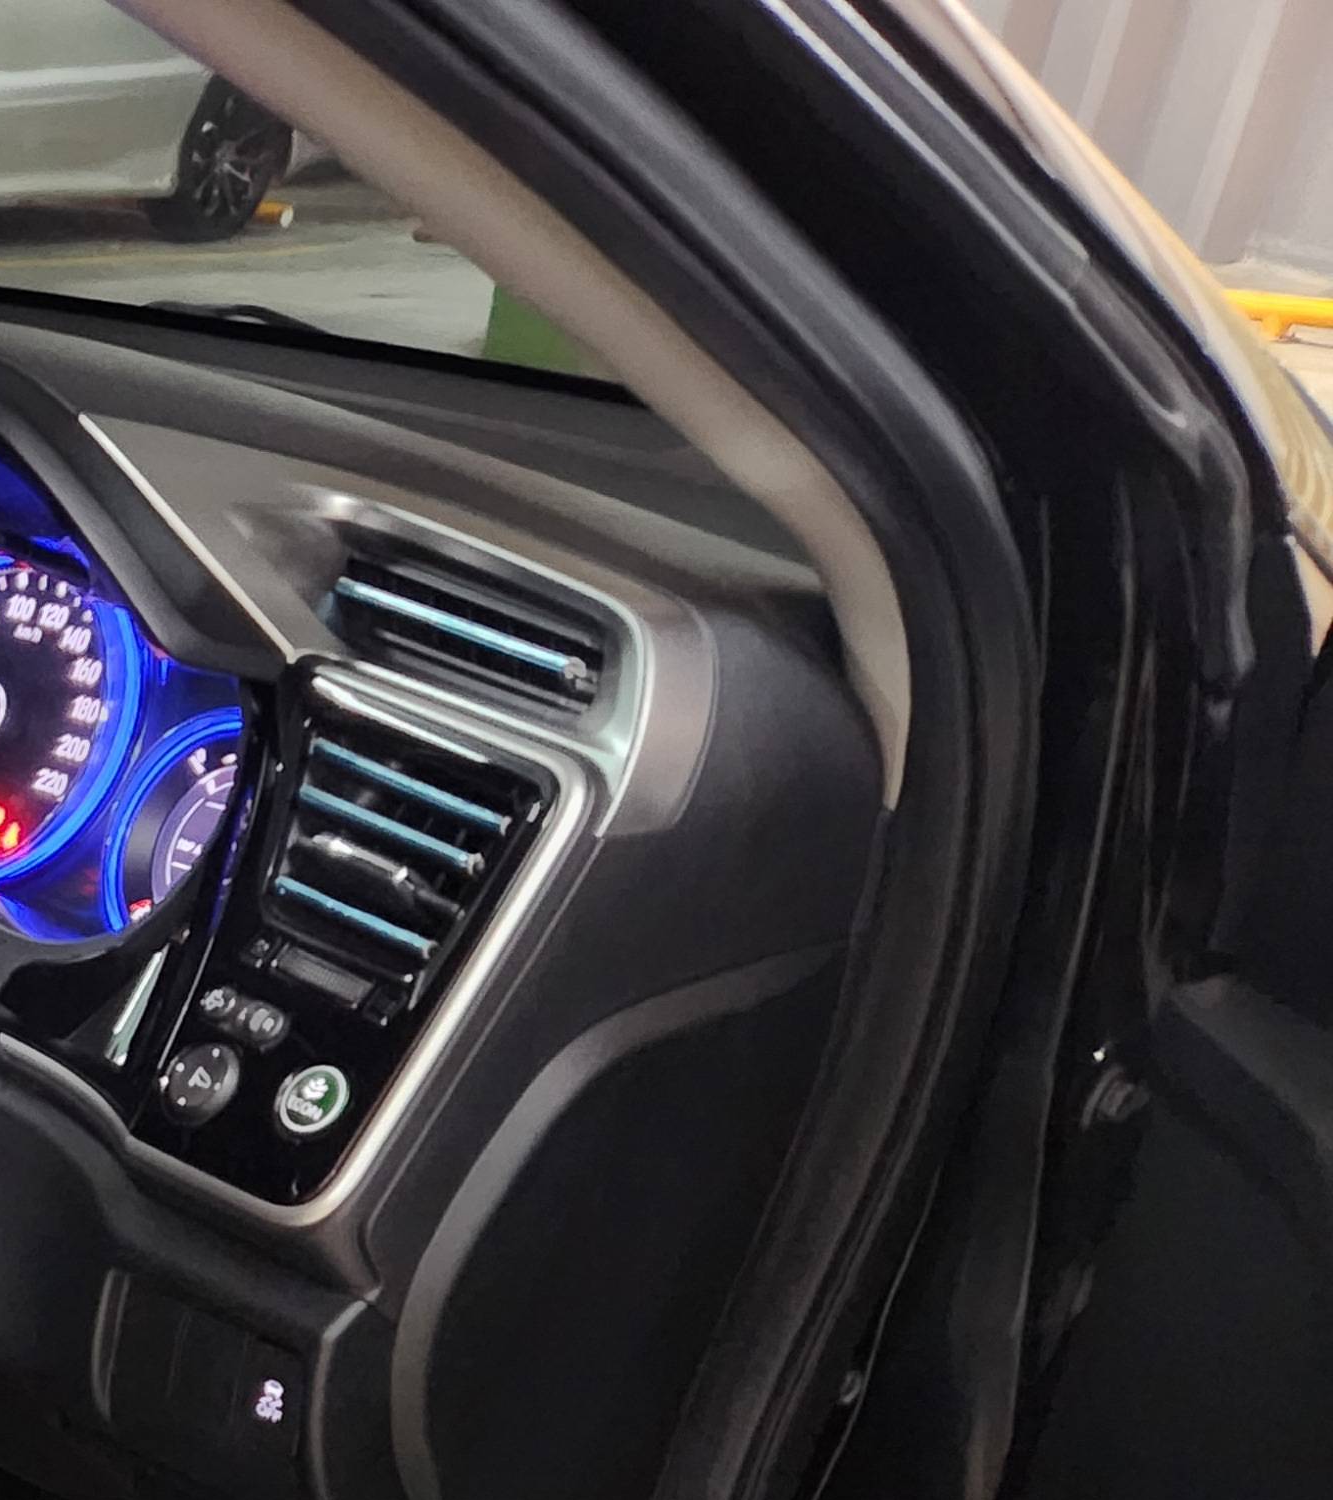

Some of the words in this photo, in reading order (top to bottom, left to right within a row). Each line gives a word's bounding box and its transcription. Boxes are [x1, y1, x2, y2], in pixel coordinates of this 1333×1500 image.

[5, 594, 37, 622] 100
[38, 603, 69, 630] 120
[58, 626, 91, 655] 140
[69, 656, 103, 688] 160
[70, 694, 101, 724] 180
[53, 733, 91, 763] 200
[32, 767, 69, 797] 220
